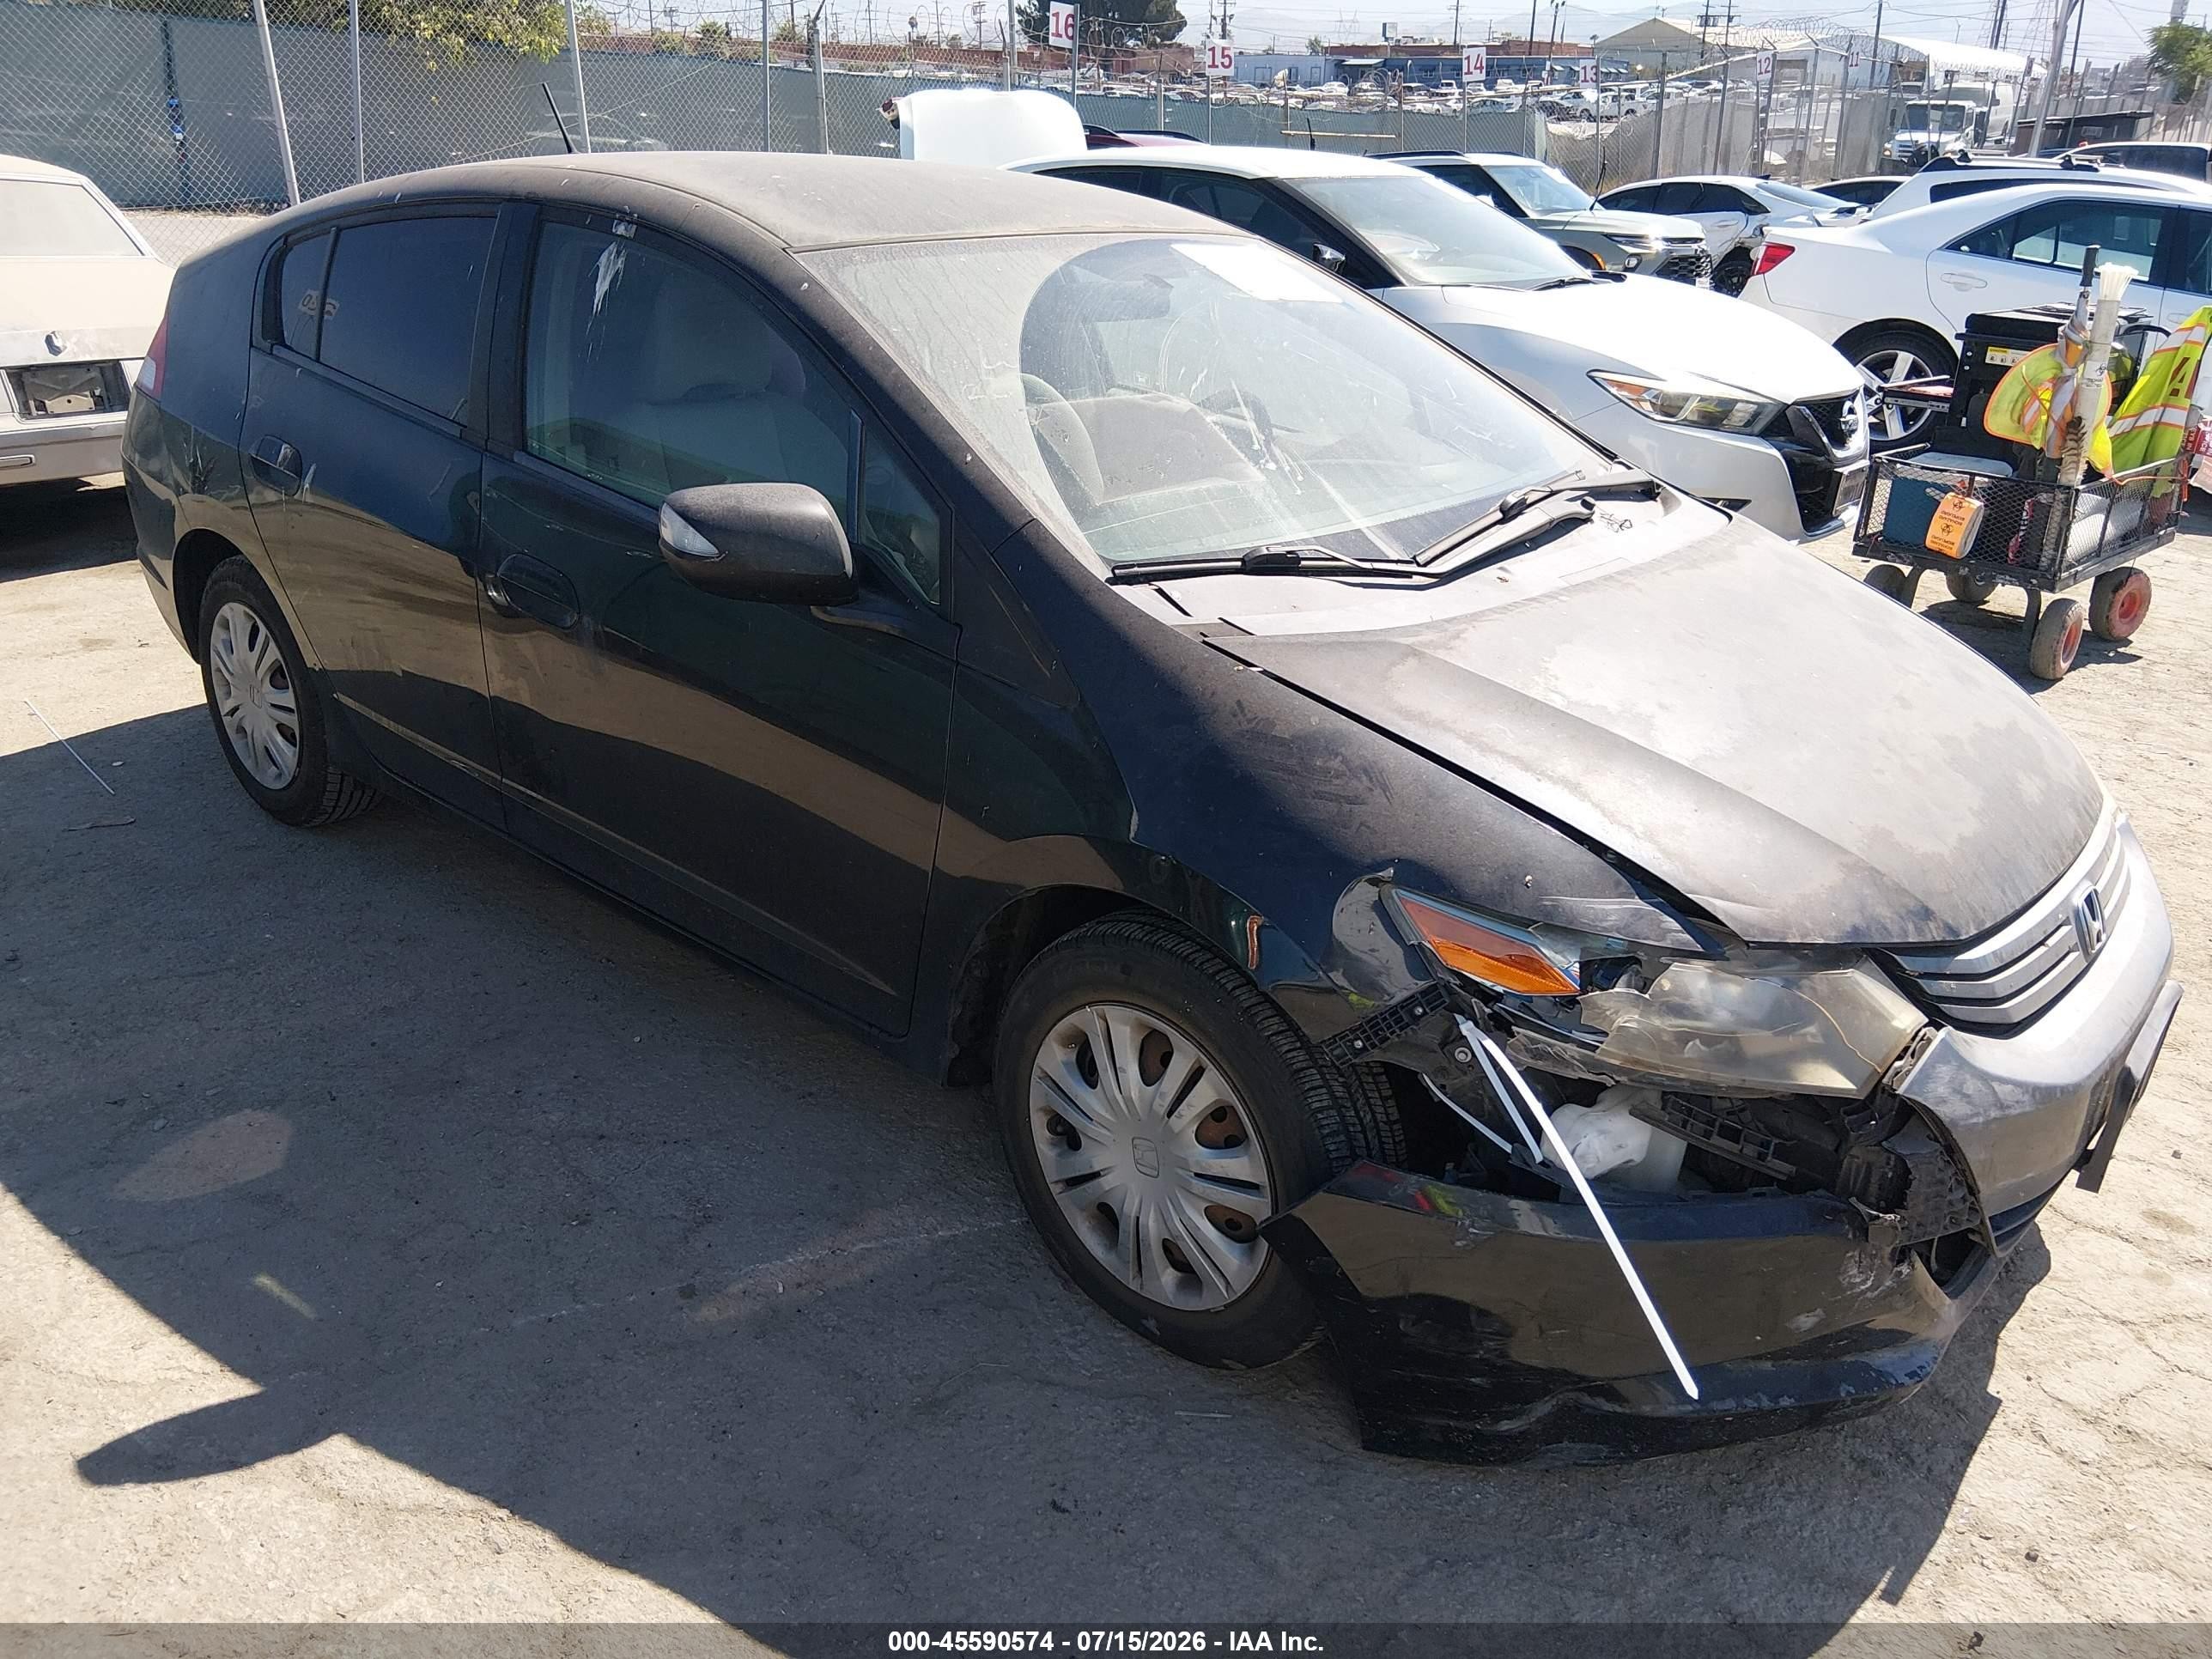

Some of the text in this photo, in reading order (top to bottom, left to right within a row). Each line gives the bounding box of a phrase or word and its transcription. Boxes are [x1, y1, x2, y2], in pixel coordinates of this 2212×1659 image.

[1051, 11, 1075, 40] 16
[1207, 46, 1233, 69] 15
[1463, 53, 1485, 76] 14
[1758, 57, 1771, 76] 12
[1849, 52, 1859, 67] 11
[1580, 64, 1598, 82] 13
